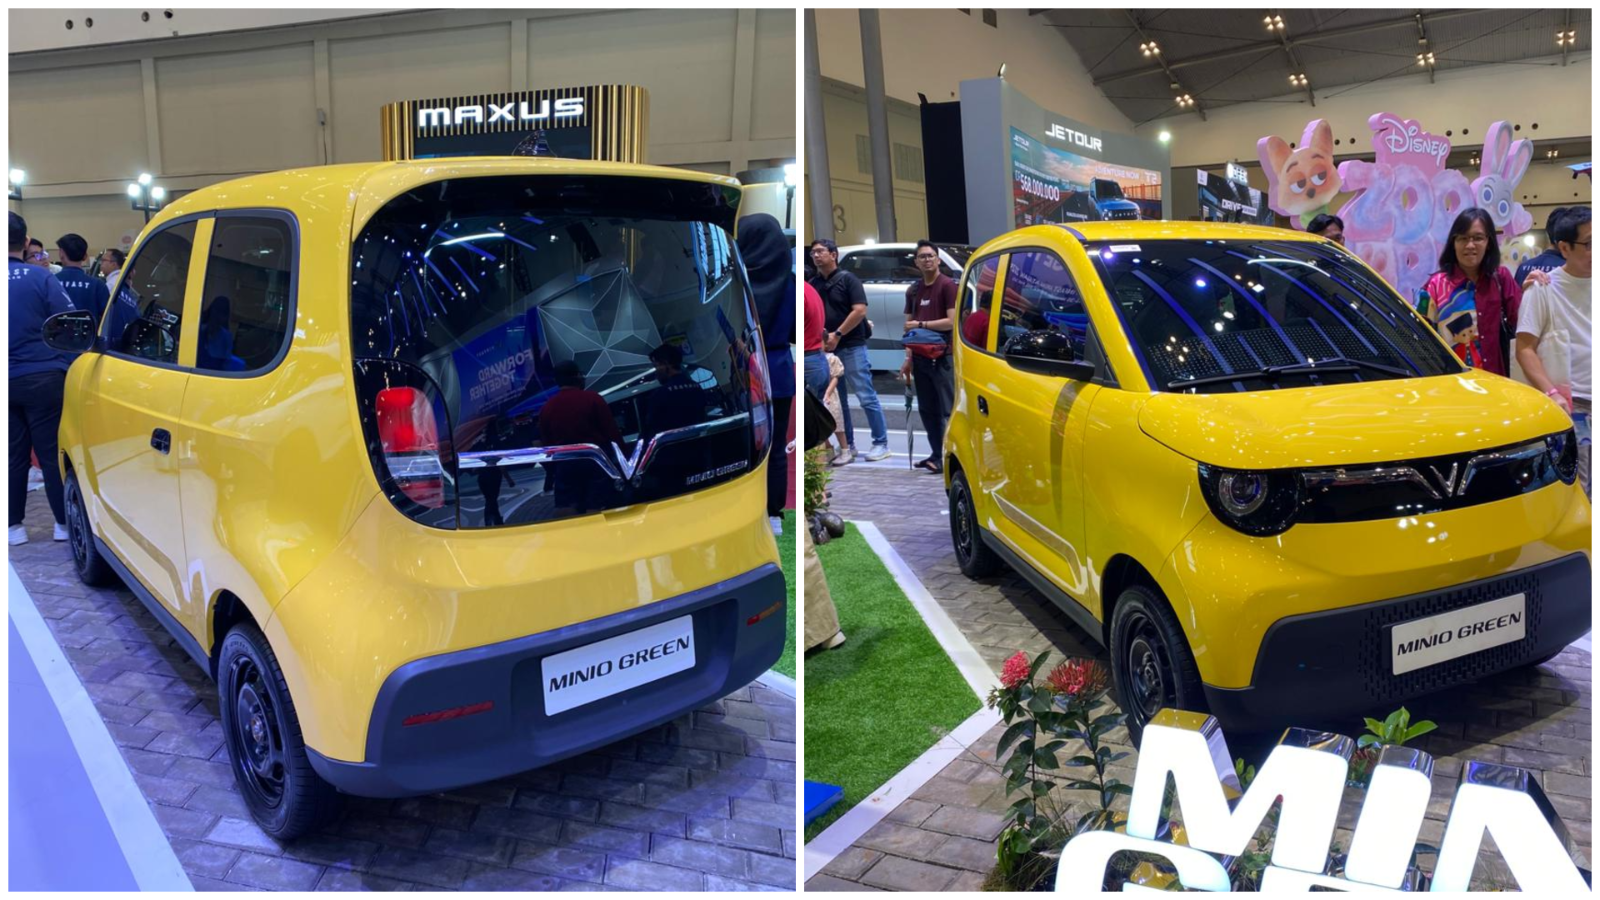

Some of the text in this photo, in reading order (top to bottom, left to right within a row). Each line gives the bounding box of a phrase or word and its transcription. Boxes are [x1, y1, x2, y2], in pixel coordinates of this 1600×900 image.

[418, 97, 584, 127] MAXUS
[1045, 123, 1103, 152] JETOUR
[1382, 118, 1449, 166] Disney
[1397, 611, 1522, 656] MINIO GREEN
[549, 635, 690, 692] MINIO GREEN
